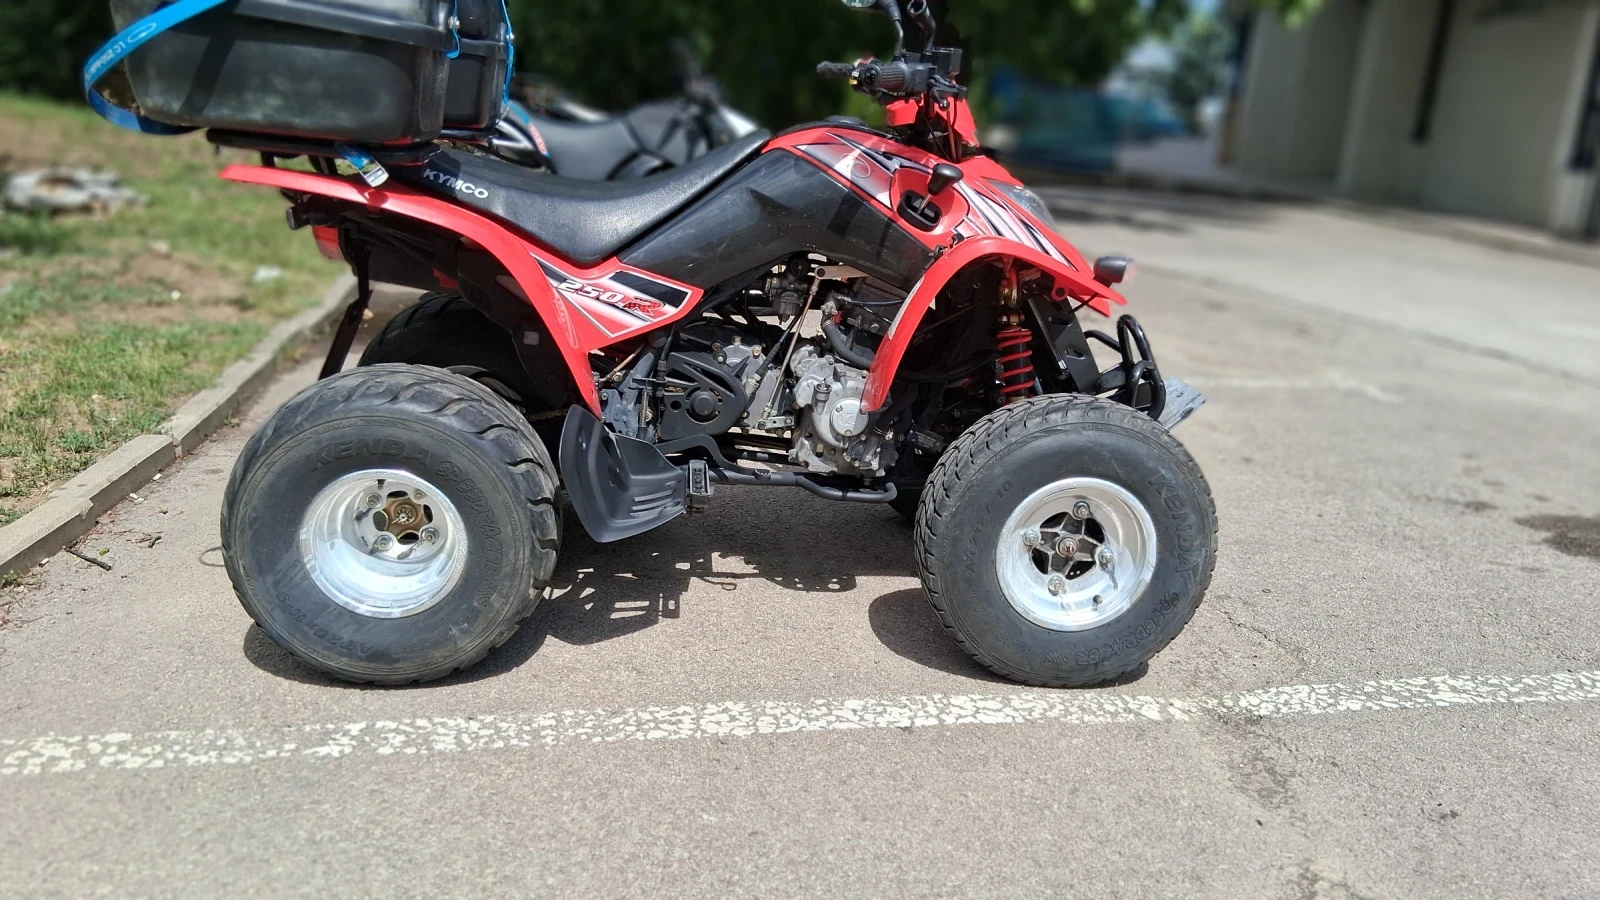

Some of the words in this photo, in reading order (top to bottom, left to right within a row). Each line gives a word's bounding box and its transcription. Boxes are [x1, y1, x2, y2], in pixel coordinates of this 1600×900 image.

[423, 168, 490, 200] KYMCO
[311, 437, 432, 472] KENDA
[1147, 473, 1195, 574] KENDA
